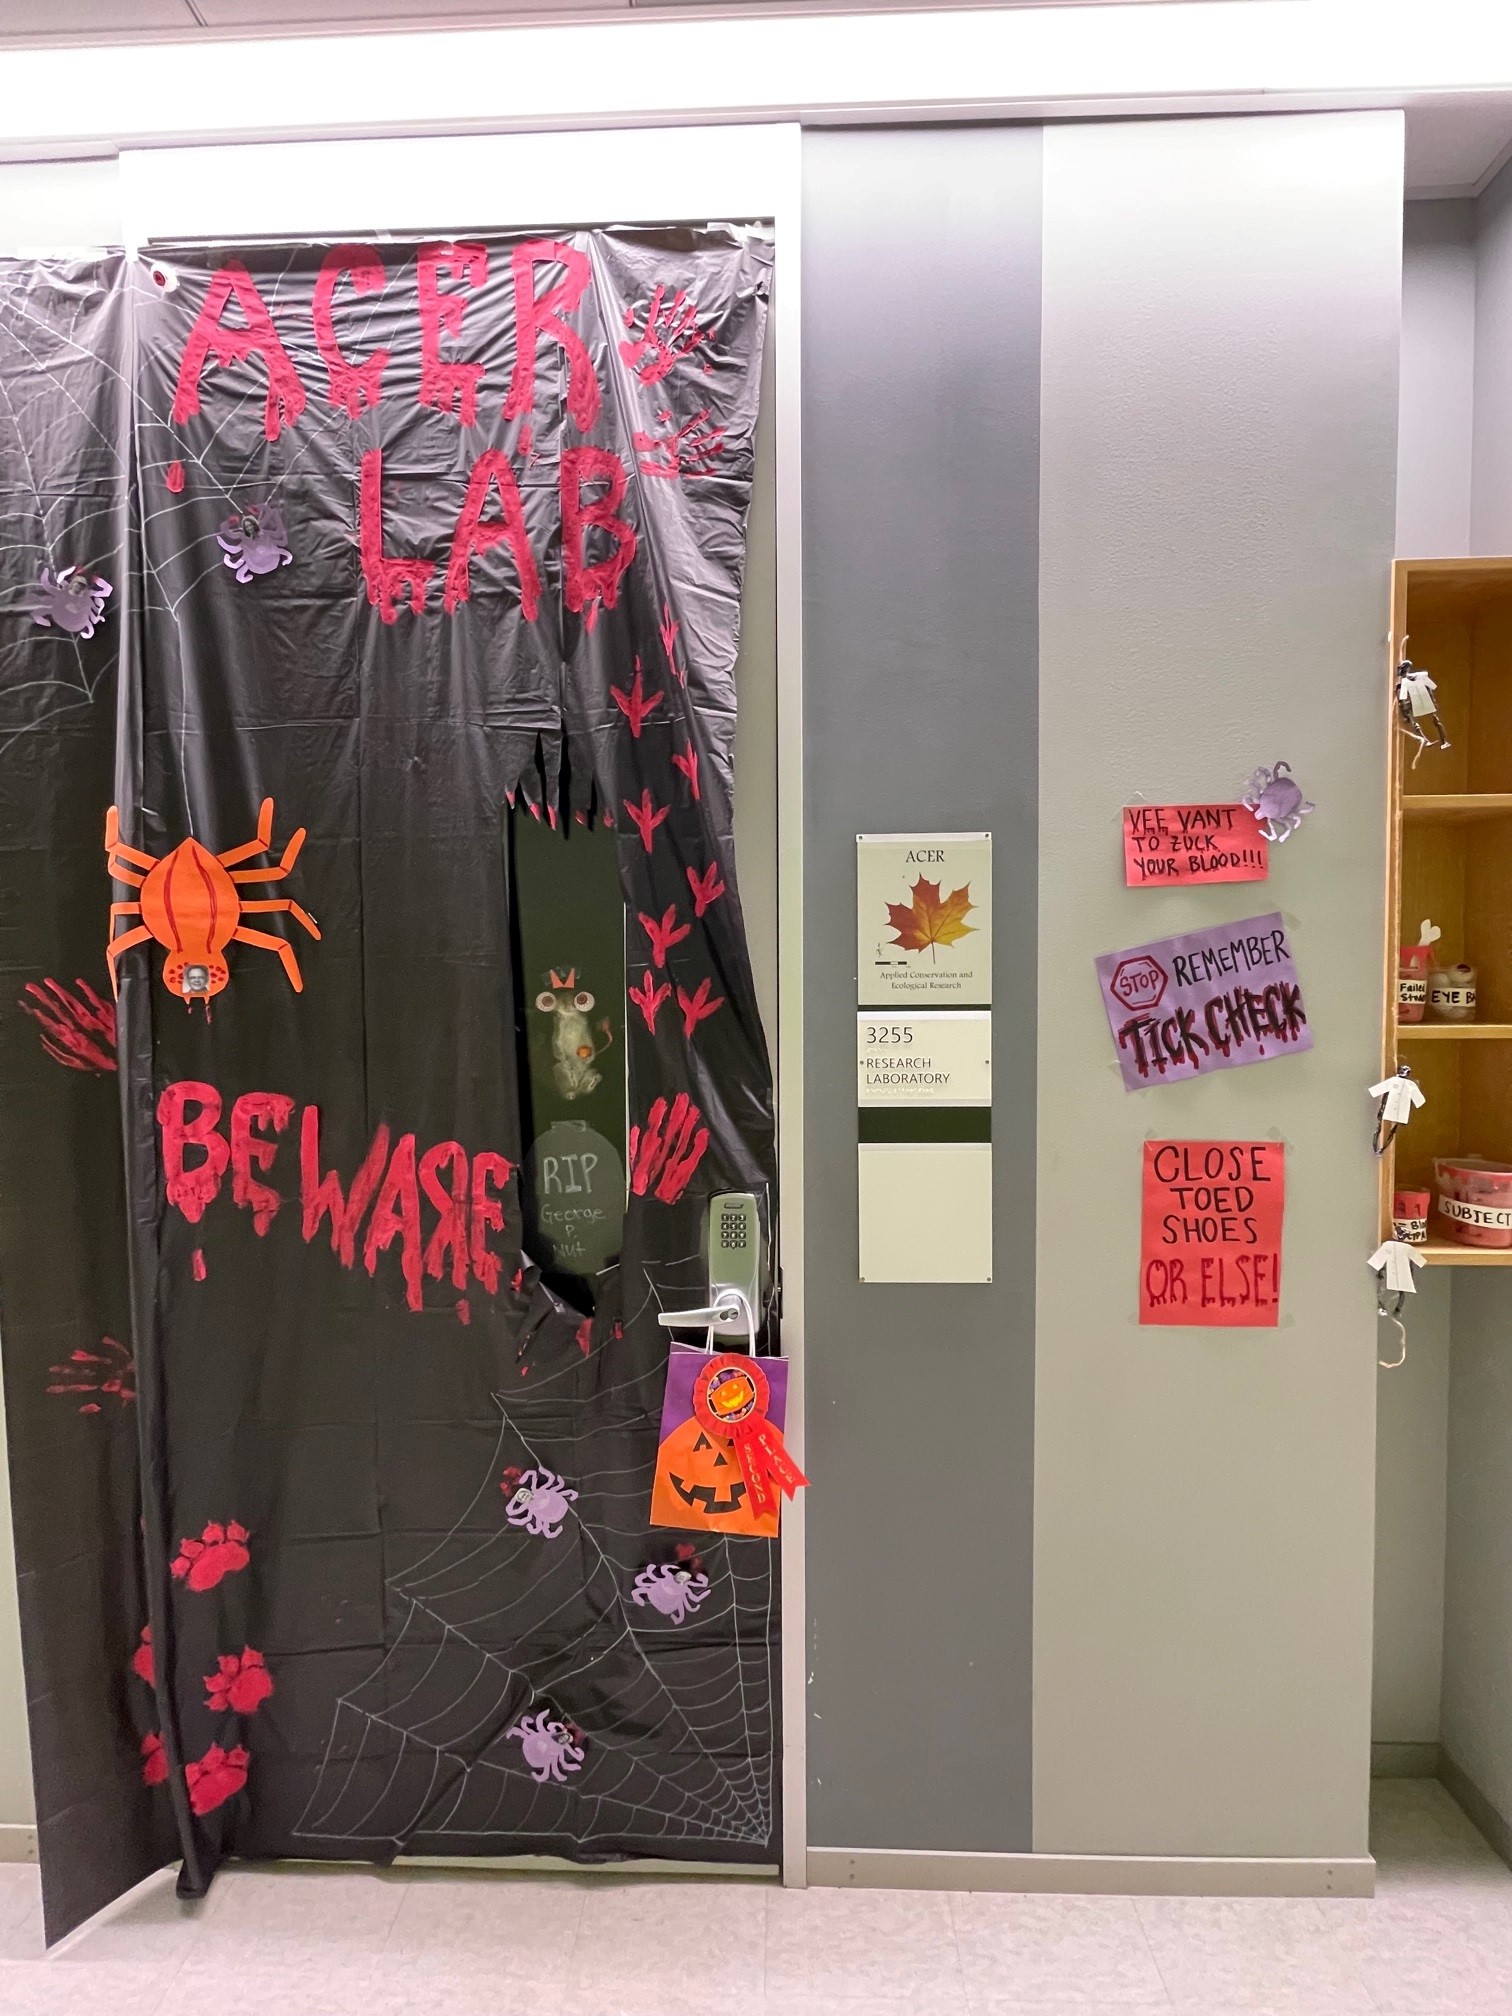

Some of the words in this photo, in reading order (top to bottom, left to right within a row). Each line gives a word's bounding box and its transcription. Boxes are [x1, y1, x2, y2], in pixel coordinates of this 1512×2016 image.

[172, 239, 603, 441] ACER
[358, 447, 637, 632] LAB
[1128, 808, 1169, 835] VEE
[1177, 808, 1236, 833] VANT
[905, 849, 945, 863] ACER
[1132, 836, 1160, 853] TO
[1170, 834, 1220, 853] ZUCK
[1134, 857, 1180, 880] YOUR
[1188, 850, 1264, 874] BLOOD!!!
[1172, 930, 1290, 987] REMEMBER
[879, 971, 908, 980] Applied
[909, 971, 957, 979] Conservation
[891, 982, 927, 991] Ecological
[1119, 970, 1159, 996] STOP
[1431, 990, 1460, 1004] EYE
[866, 1026, 913, 1044] 3255
[1117, 1006, 1210, 1078] TICK
[1205, 981, 1306, 1057] CHECK
[866, 1057, 932, 1069] RESEARCH
[866, 1072, 951, 1085] LABORATORY
[543, 1153, 598, 1194] RIP
[1153, 1145, 1271, 1183] CLOSE
[157, 1080, 513, 1312] BEWARE
[1169, 1186, 1254, 1213] TOED
[541, 1204, 607, 1225] George
[1444, 1201, 1511, 1226] SUBJECT
[1162, 1214, 1258, 1244] SHOES
[1146, 1258, 1188, 1307] OR
[1201, 1253, 1278, 1307] ELSE!
[758, 1434, 794, 1484] PLACE
[744, 1443, 766, 1504] SECOND
